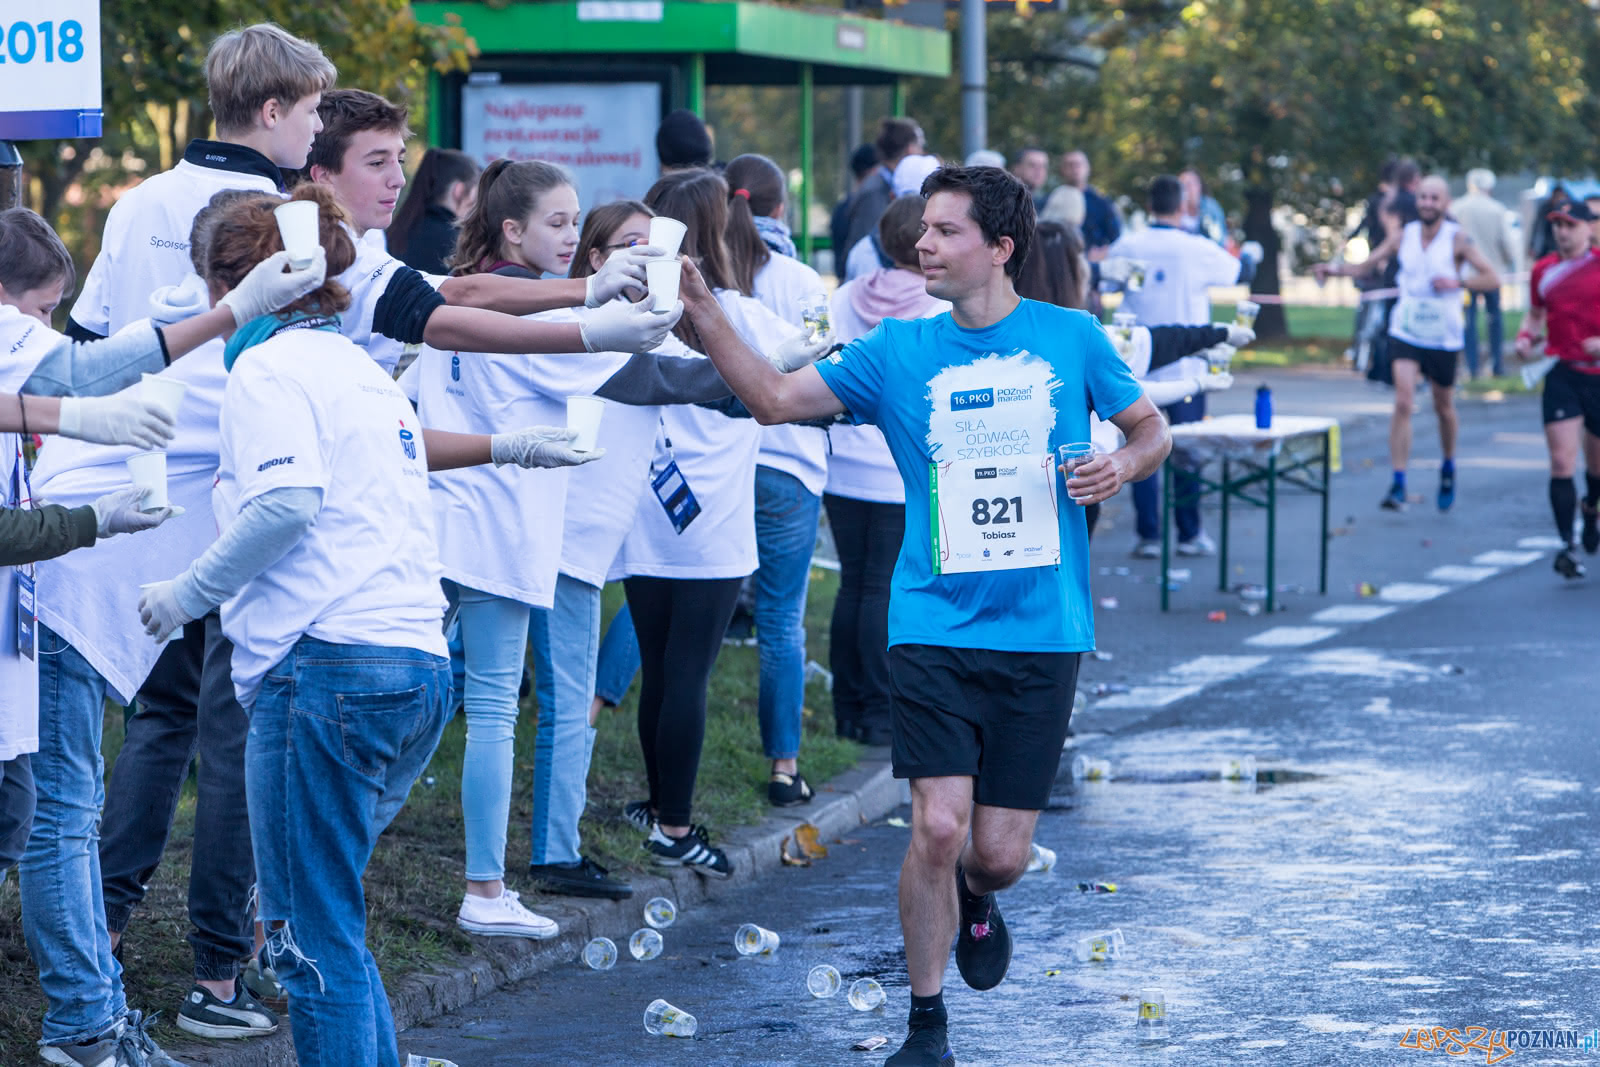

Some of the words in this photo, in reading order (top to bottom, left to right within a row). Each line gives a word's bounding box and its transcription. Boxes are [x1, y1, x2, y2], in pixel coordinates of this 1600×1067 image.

[0, 20, 84, 64] 018
[968, 393, 990, 404] PKO
[997, 394, 1032, 403] maraton
[955, 418, 987, 433] SIŁA
[965, 429, 1030, 446] ODWAGA
[957, 440, 1032, 461] SZYBKOŚĆ
[257, 456, 295, 472] 4MOVE
[971, 495, 1024, 526] 821
[981, 531, 1017, 540] Tobiasz
